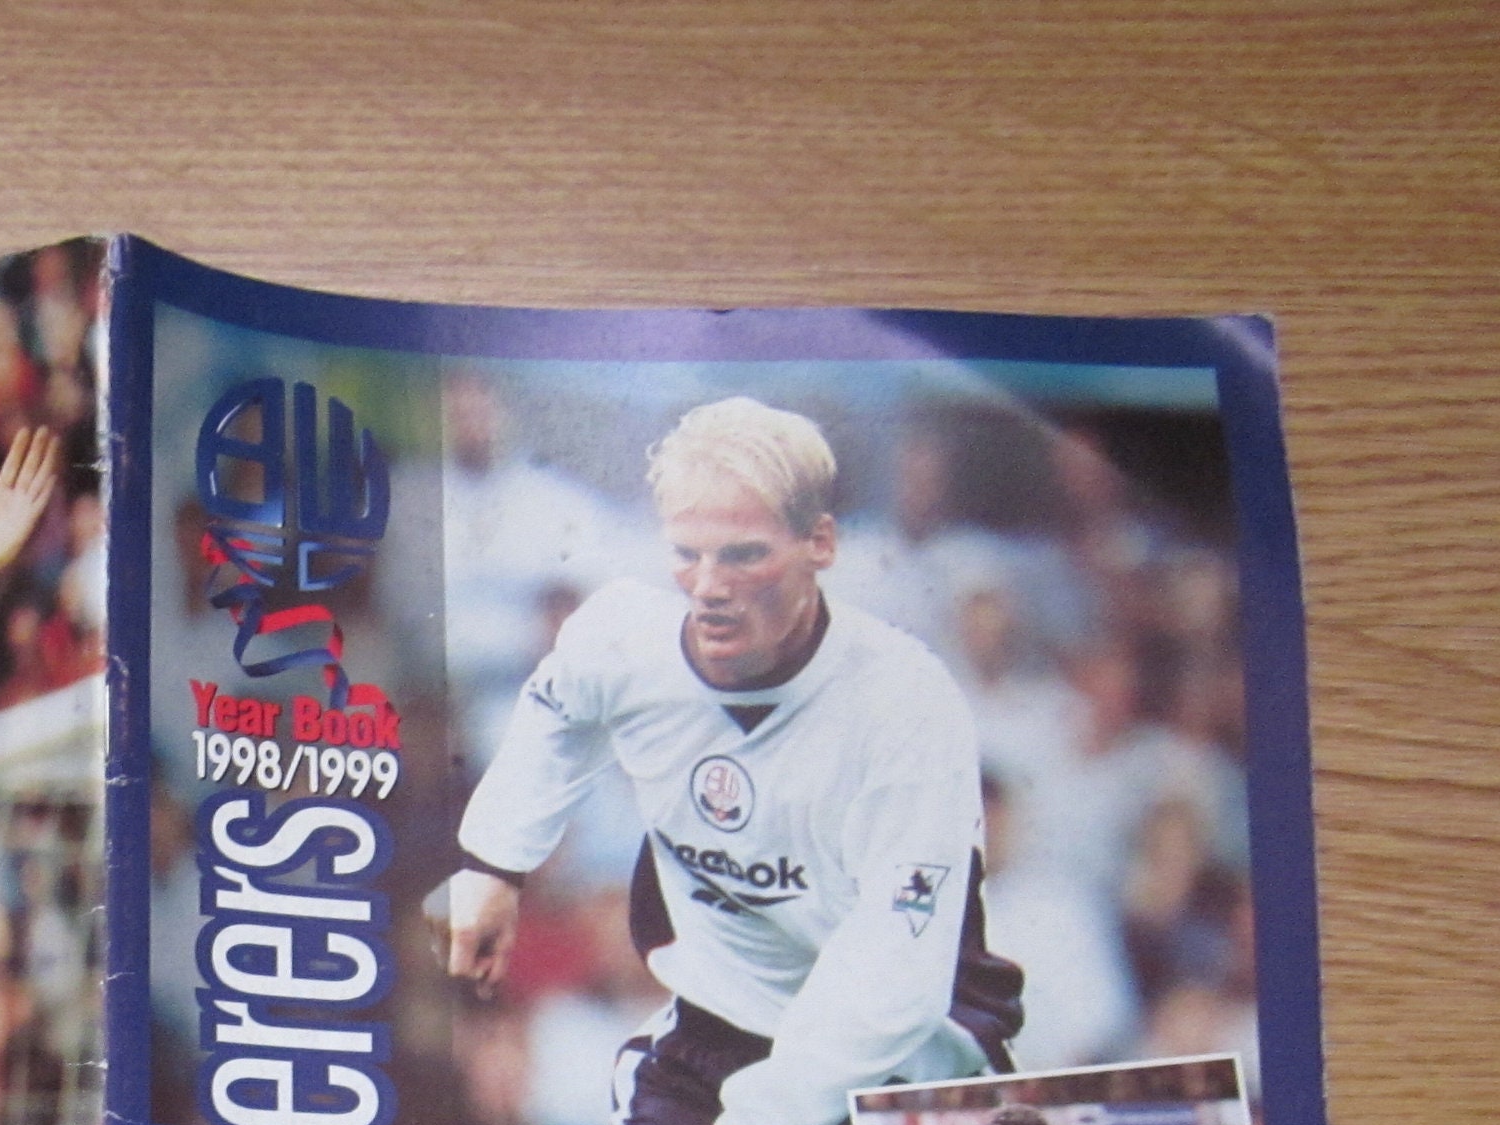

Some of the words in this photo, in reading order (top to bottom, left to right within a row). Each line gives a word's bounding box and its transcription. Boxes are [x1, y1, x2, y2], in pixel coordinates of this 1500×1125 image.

[189, 678, 280, 738] Year
[292, 695, 401, 750] Book
[191, 730, 399, 800] 1998/1999
[674, 843, 810, 891] eebok
